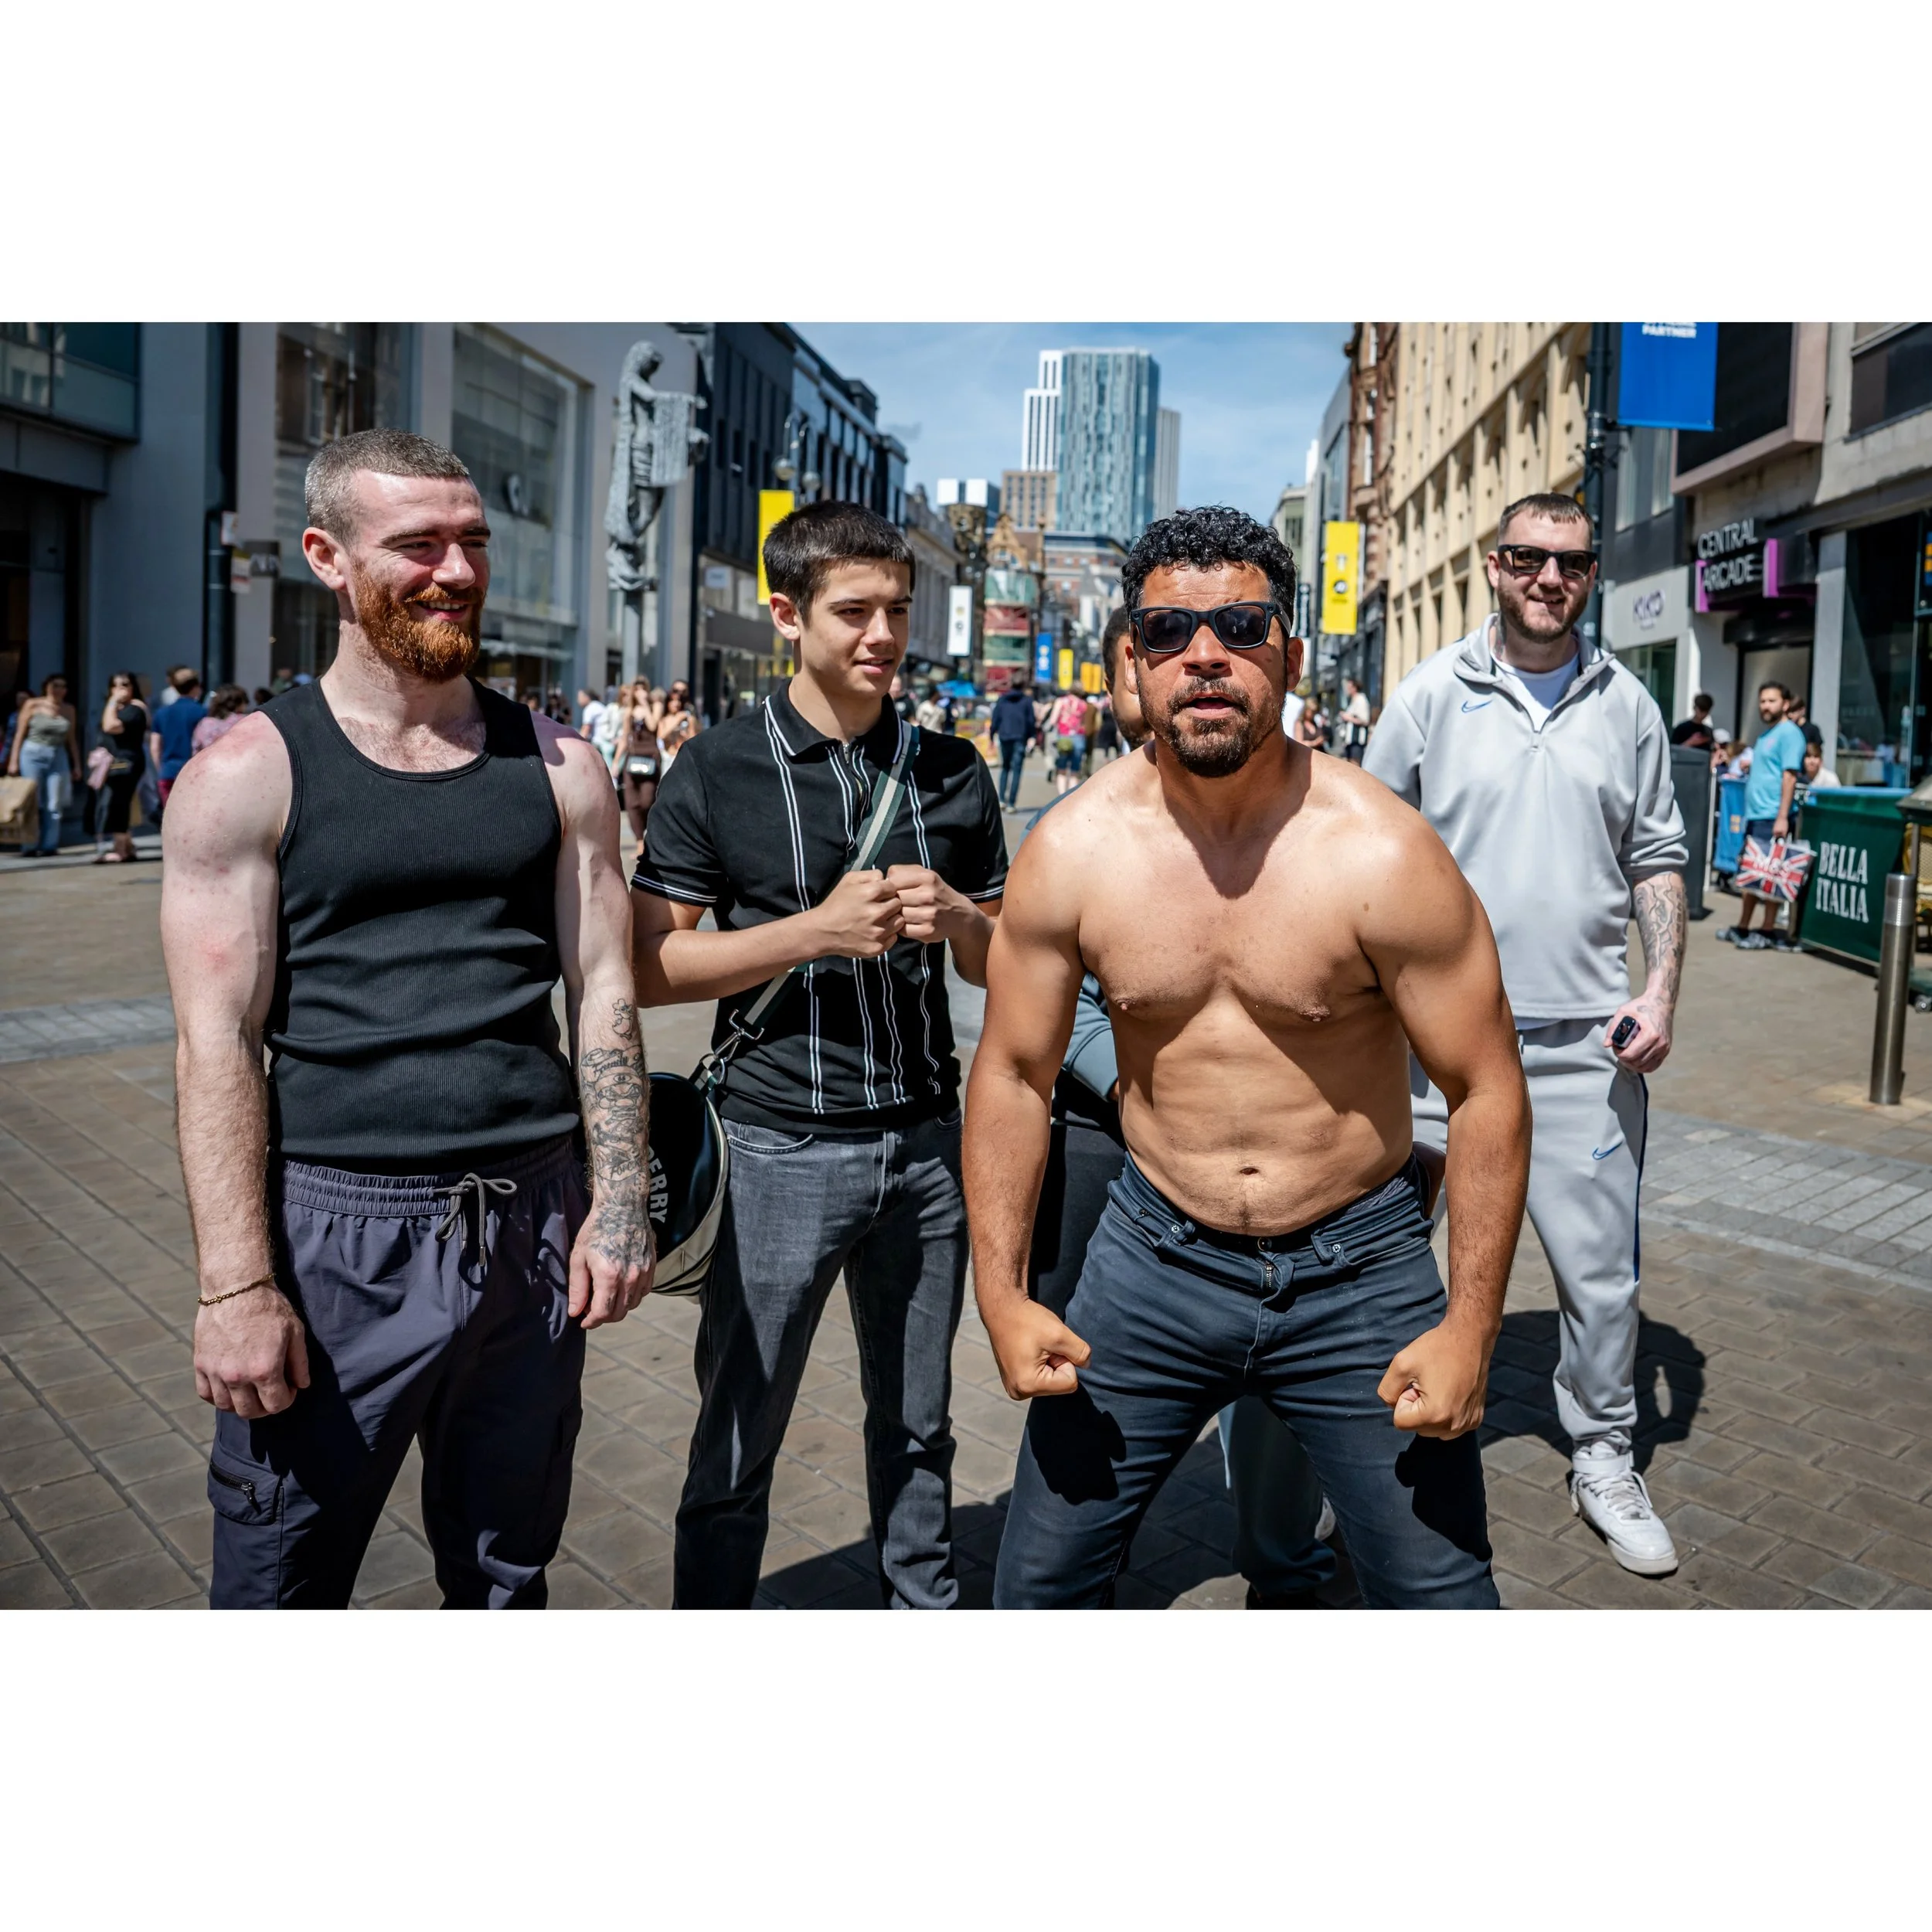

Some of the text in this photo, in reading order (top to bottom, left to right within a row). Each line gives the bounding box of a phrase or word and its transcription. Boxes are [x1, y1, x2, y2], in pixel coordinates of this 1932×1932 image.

[1698, 517, 1759, 559] CENTRAL
[1702, 553, 1760, 592] ARCADE
[1818, 841, 1868, 885] BELLA
[1816, 876, 1869, 923] ITALIA
